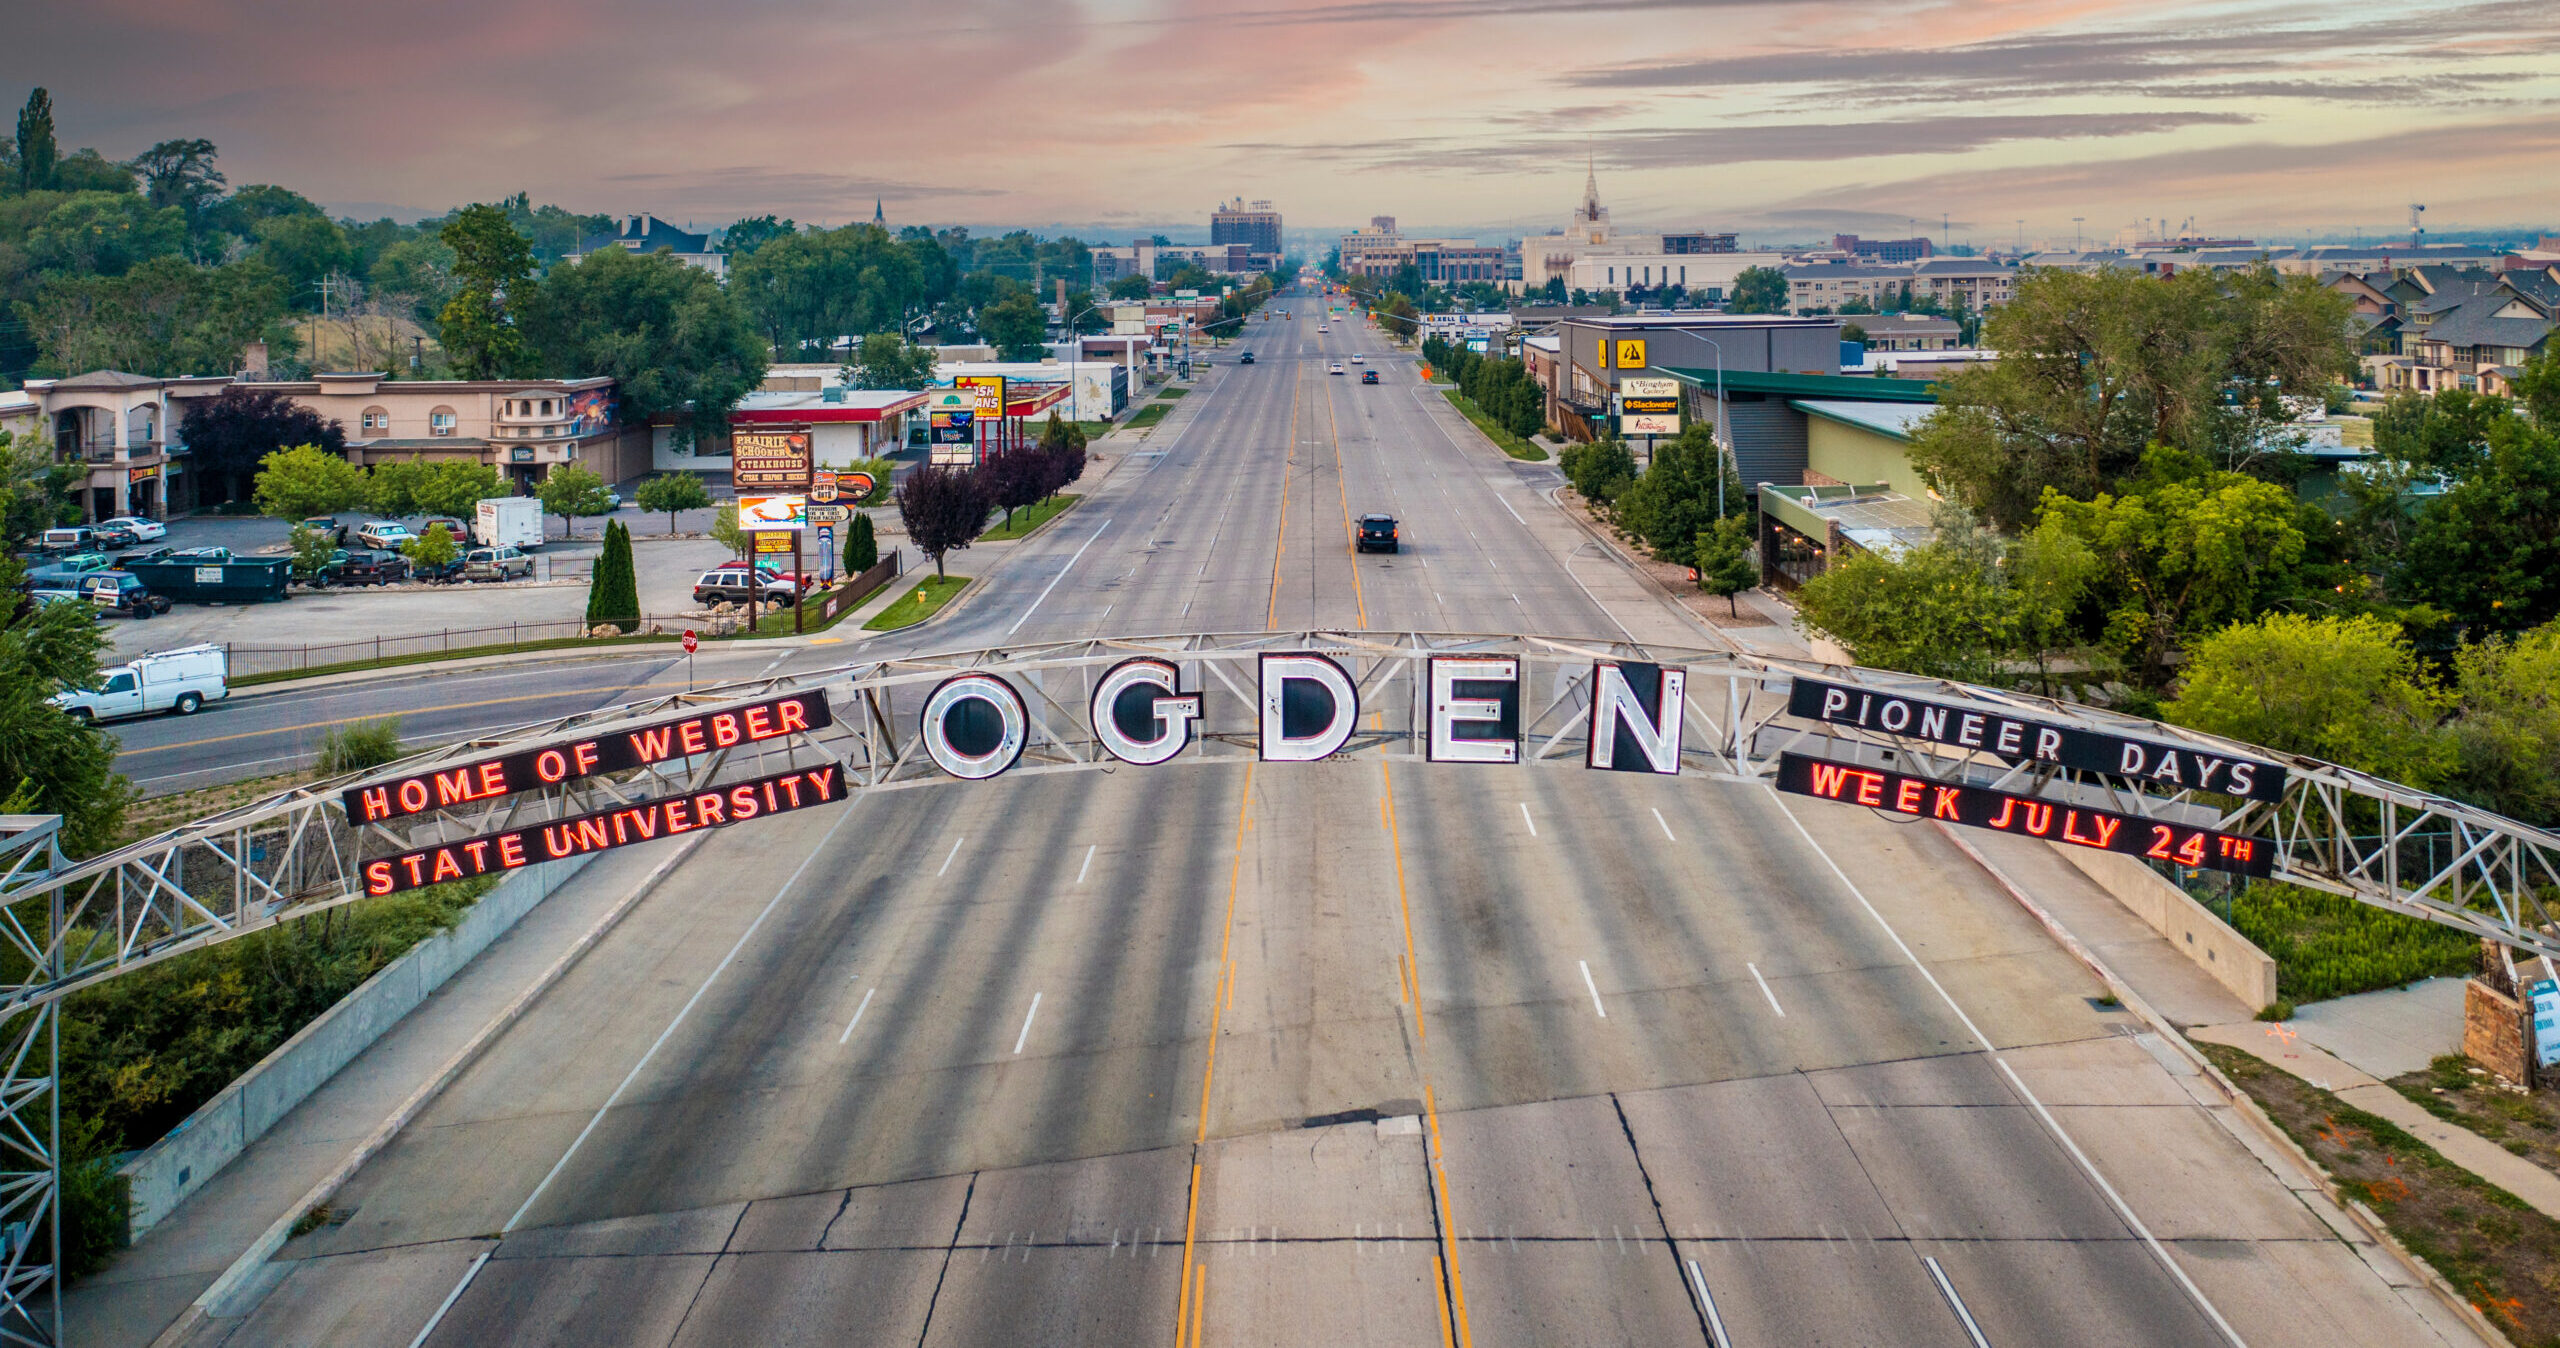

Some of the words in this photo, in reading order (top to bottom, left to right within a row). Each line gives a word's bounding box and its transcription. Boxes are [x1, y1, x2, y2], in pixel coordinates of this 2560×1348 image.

[1632, 401, 1676, 409] Slackwater
[736, 435, 785, 448] PRAIRIE
[736, 446, 785, 457] SCHOONER
[741, 459, 803, 469] STEAKHOUSE
[683, 636, 697, 646] STOP
[920, 651, 1687, 780] OGDEN
[1822, 688, 2063, 762] PIONEER
[2120, 742, 2257, 796] DAYS
[363, 761, 508, 822] HOME
[537, 742, 599, 783] OF
[630, 700, 809, 763] WEBER
[367, 834, 527, 895] STATE
[544, 768, 834, 858] UNIVERSITY
[1811, 763, 1961, 821] WEEK
[1989, 798, 2121, 848] JULY
[2147, 825, 2253, 867] 24TH
